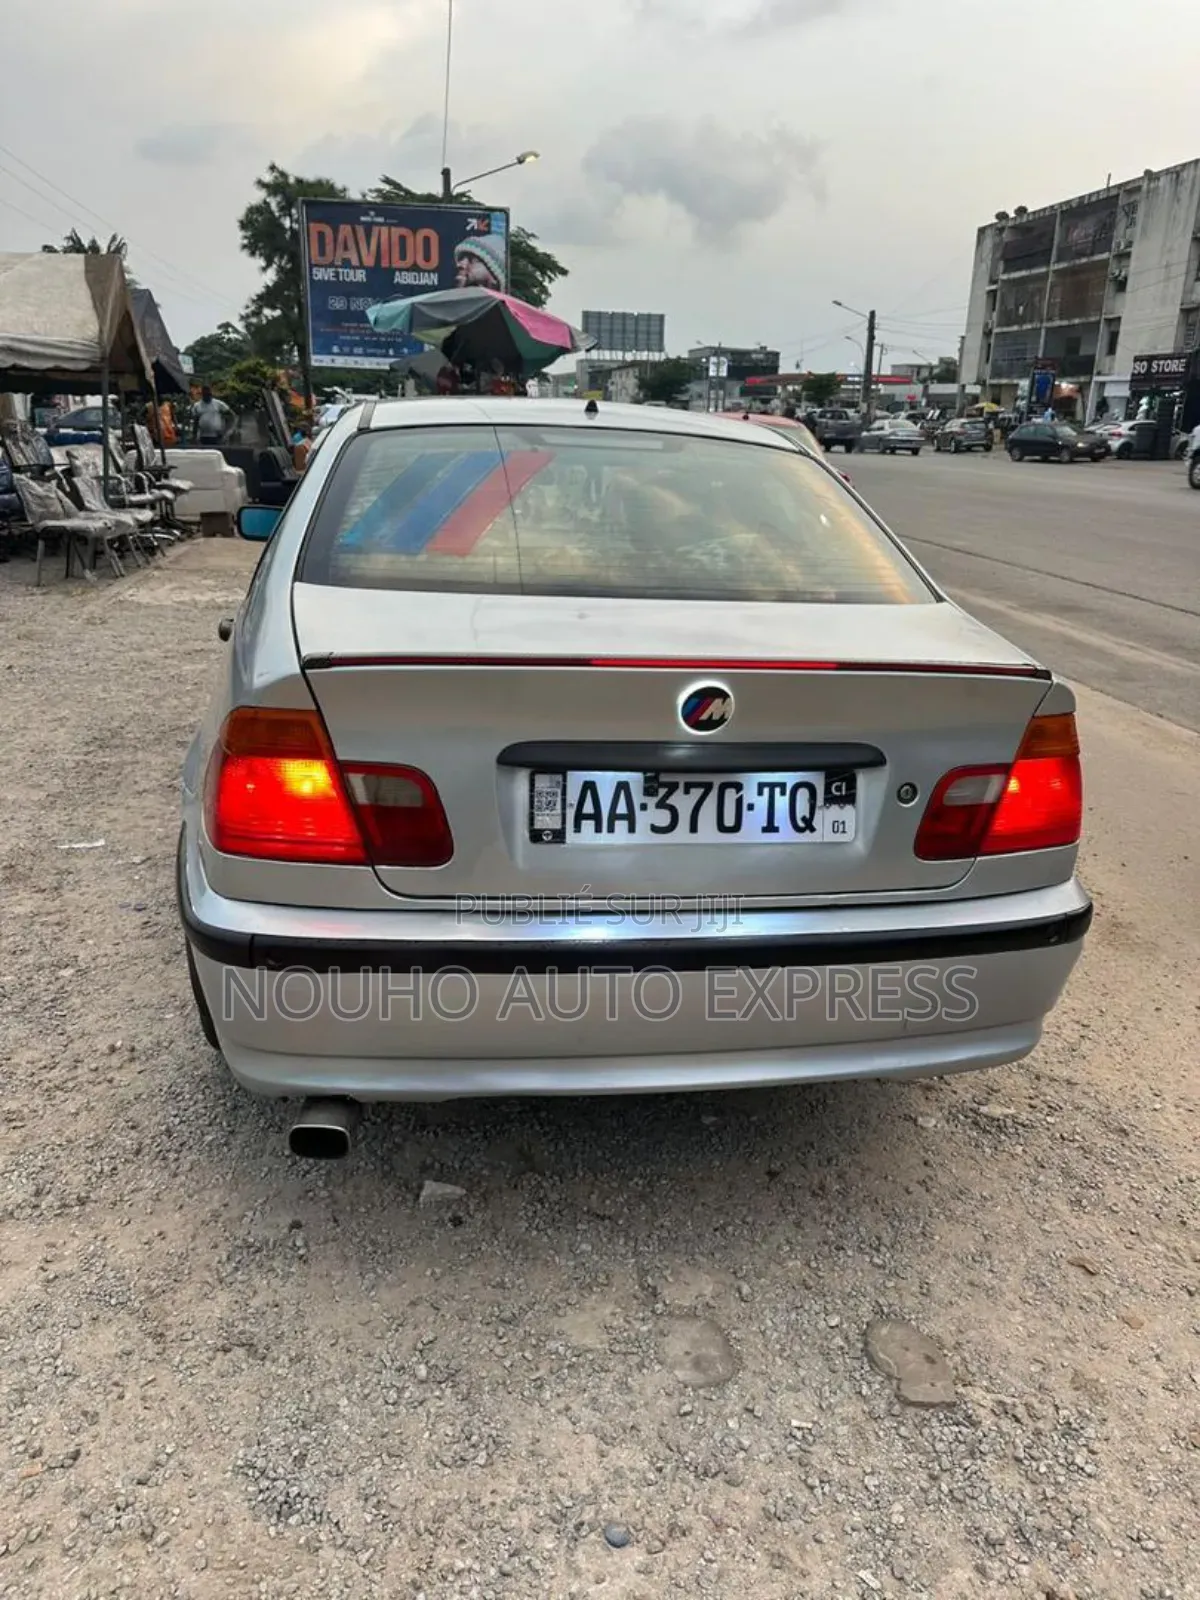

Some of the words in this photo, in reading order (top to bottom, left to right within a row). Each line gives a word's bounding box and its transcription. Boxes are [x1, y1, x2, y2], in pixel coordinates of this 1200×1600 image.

[308, 222, 440, 271] DAVIDO
[338, 268, 367, 283] TOUR
[393, 271, 439, 286] ABIDJAN
[1133, 361, 1148, 374] SO
[1151, 359, 1187, 373] STORE
[831, 781, 847, 796] CI
[832, 820, 847, 835] 01
